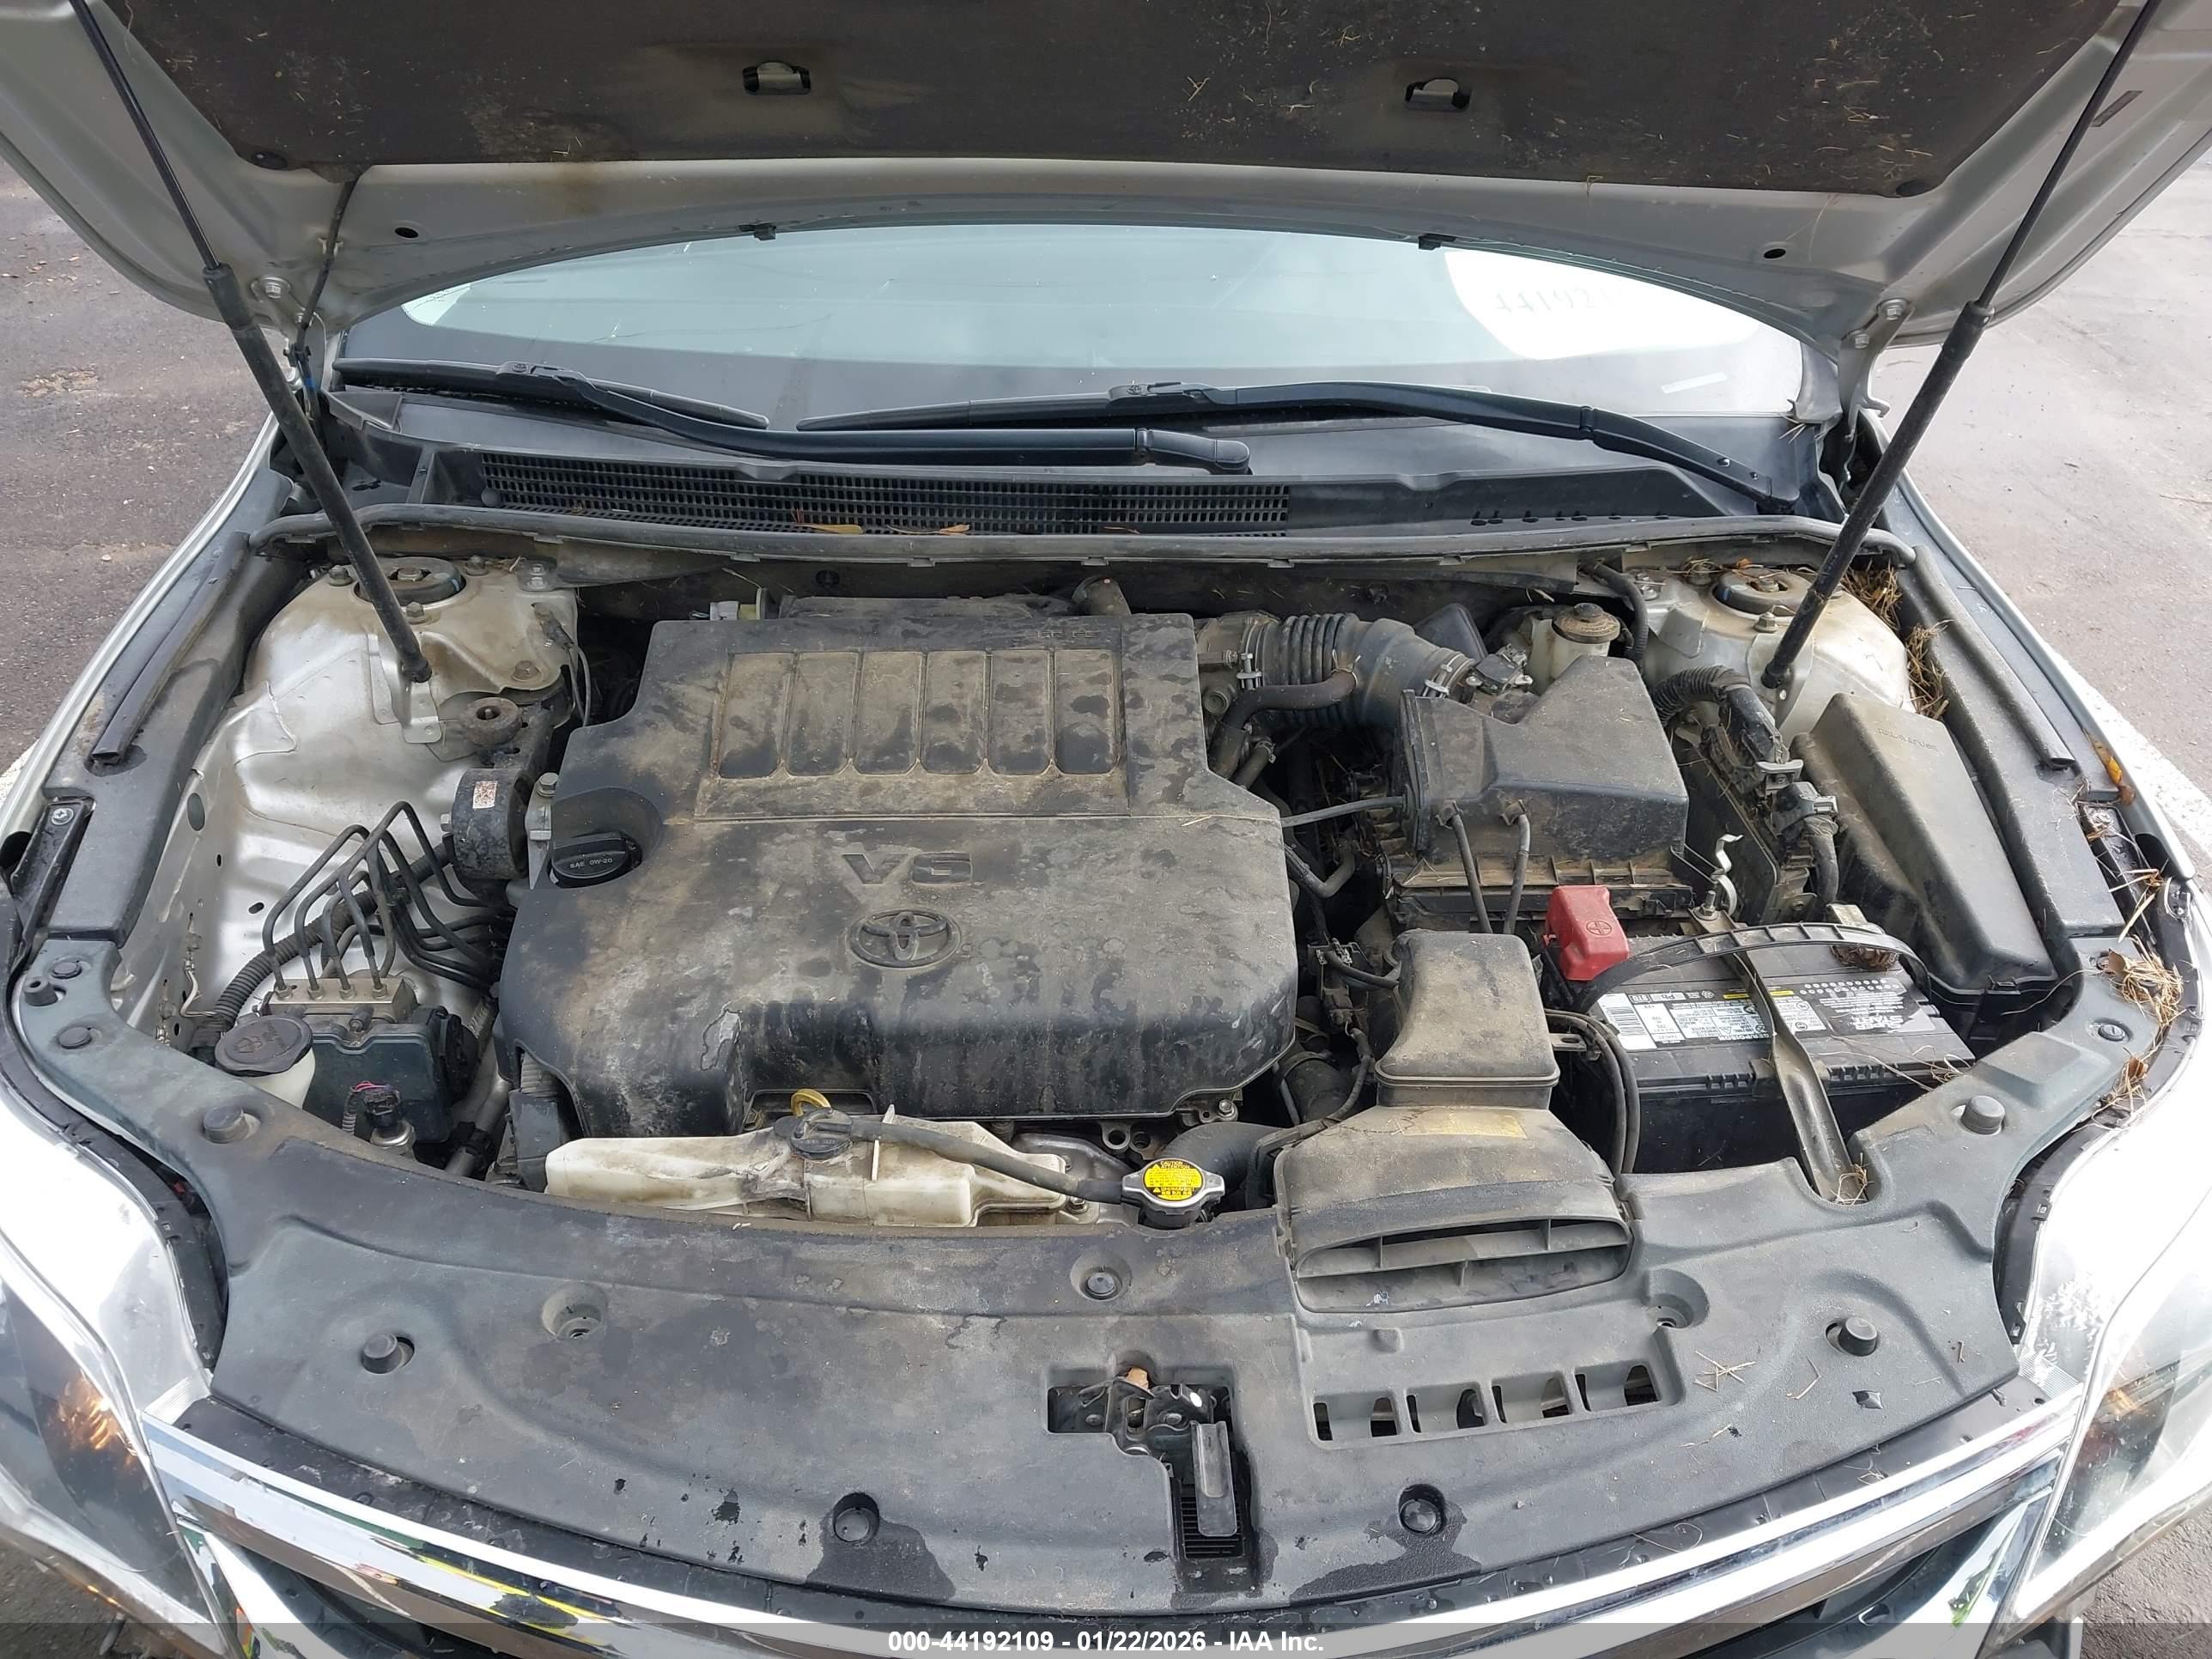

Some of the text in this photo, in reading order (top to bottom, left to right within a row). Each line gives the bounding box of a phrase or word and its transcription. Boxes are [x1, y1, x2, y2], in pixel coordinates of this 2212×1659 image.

[569, 857, 613, 869] SAE 0W-20
[842, 851, 973, 885] V6
